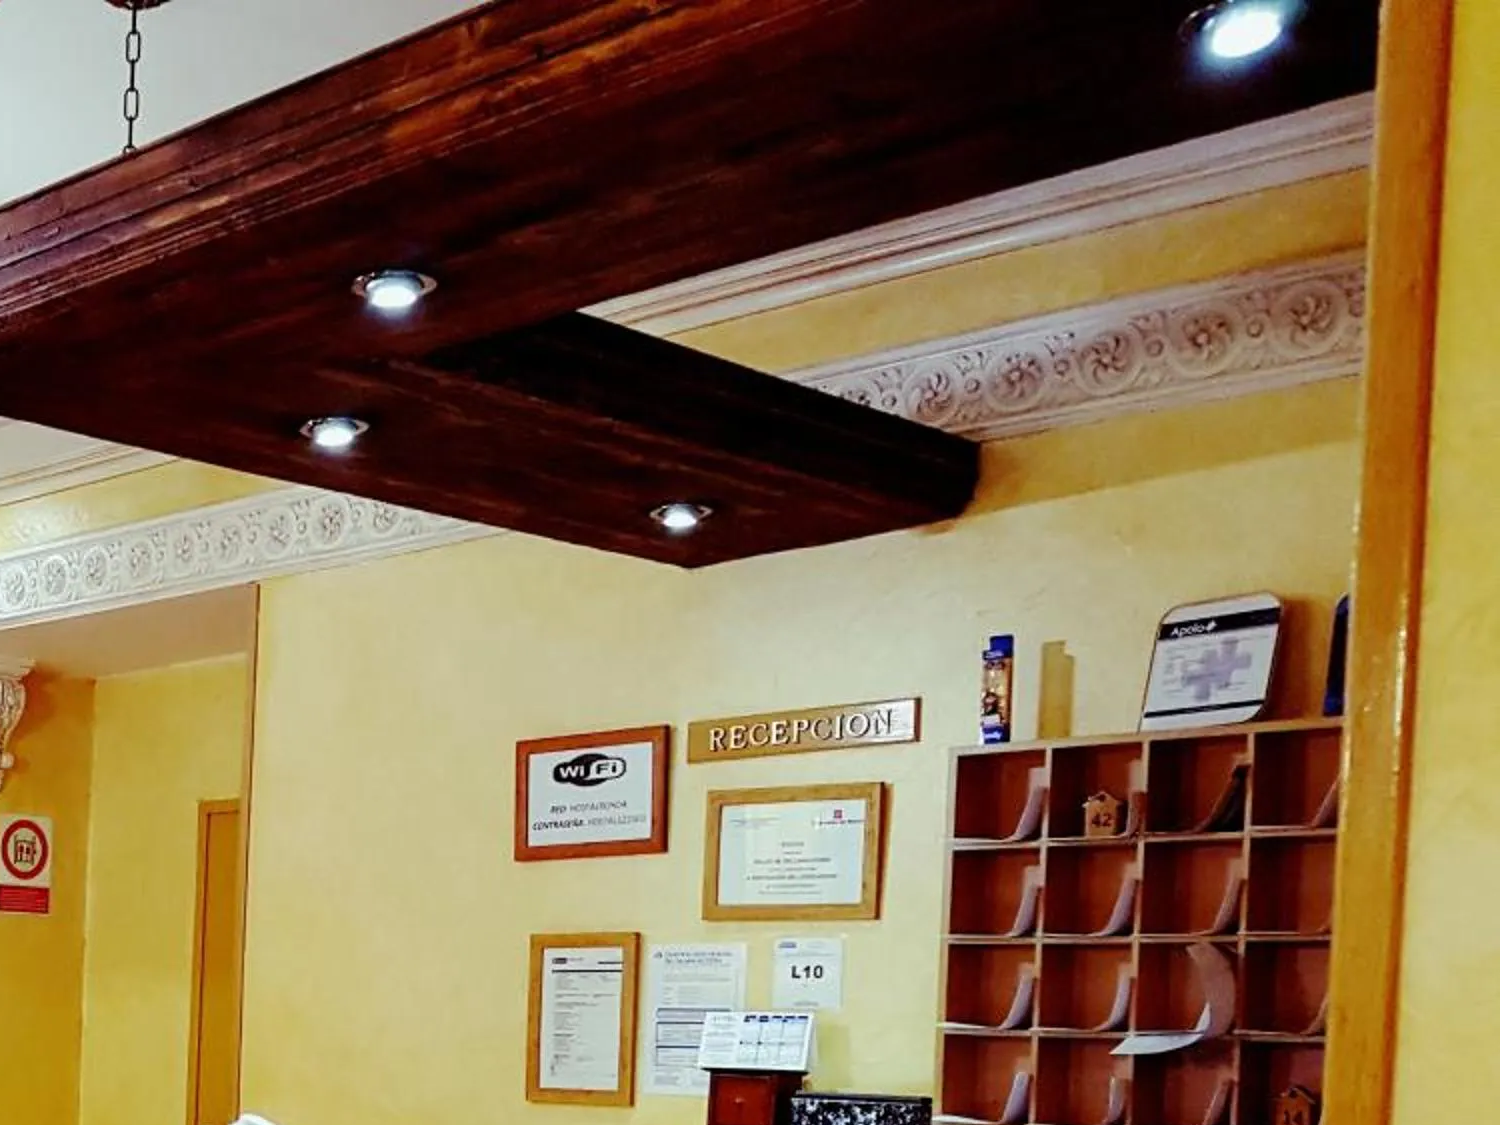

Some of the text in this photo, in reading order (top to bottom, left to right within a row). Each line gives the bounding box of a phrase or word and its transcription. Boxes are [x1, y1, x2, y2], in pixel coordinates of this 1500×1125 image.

[709, 708, 893, 752] RECEPCION
[1091, 812, 1112, 828] 42
[791, 964, 824, 980] L10
